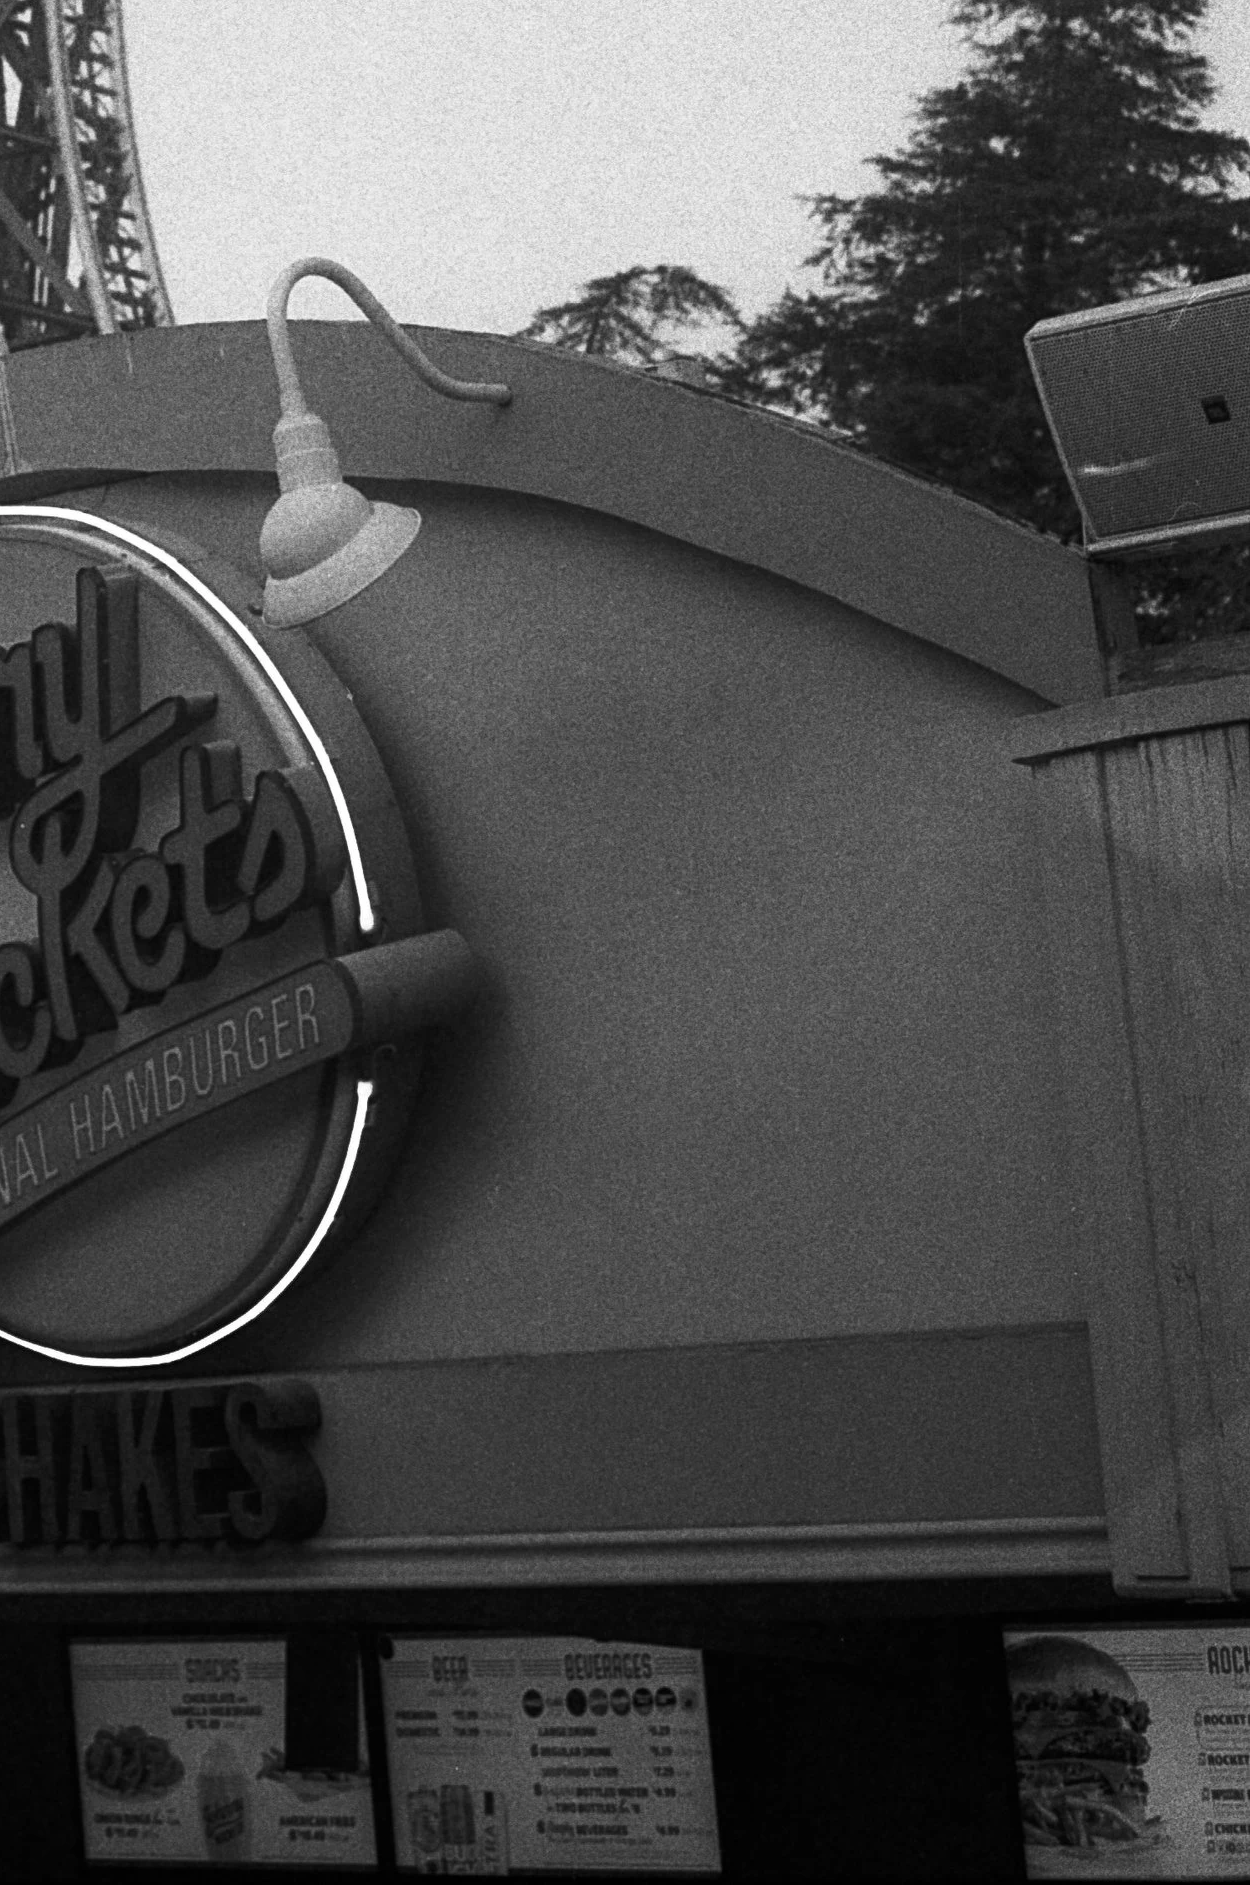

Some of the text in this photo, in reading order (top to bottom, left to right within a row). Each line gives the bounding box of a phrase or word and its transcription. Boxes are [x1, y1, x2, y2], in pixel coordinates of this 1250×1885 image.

[69, 983, 320, 1161] HAMBURGER
[564, 1653, 652, 1681] BEVERAGES
[1203, 1714, 1245, 1725] ROCKET
